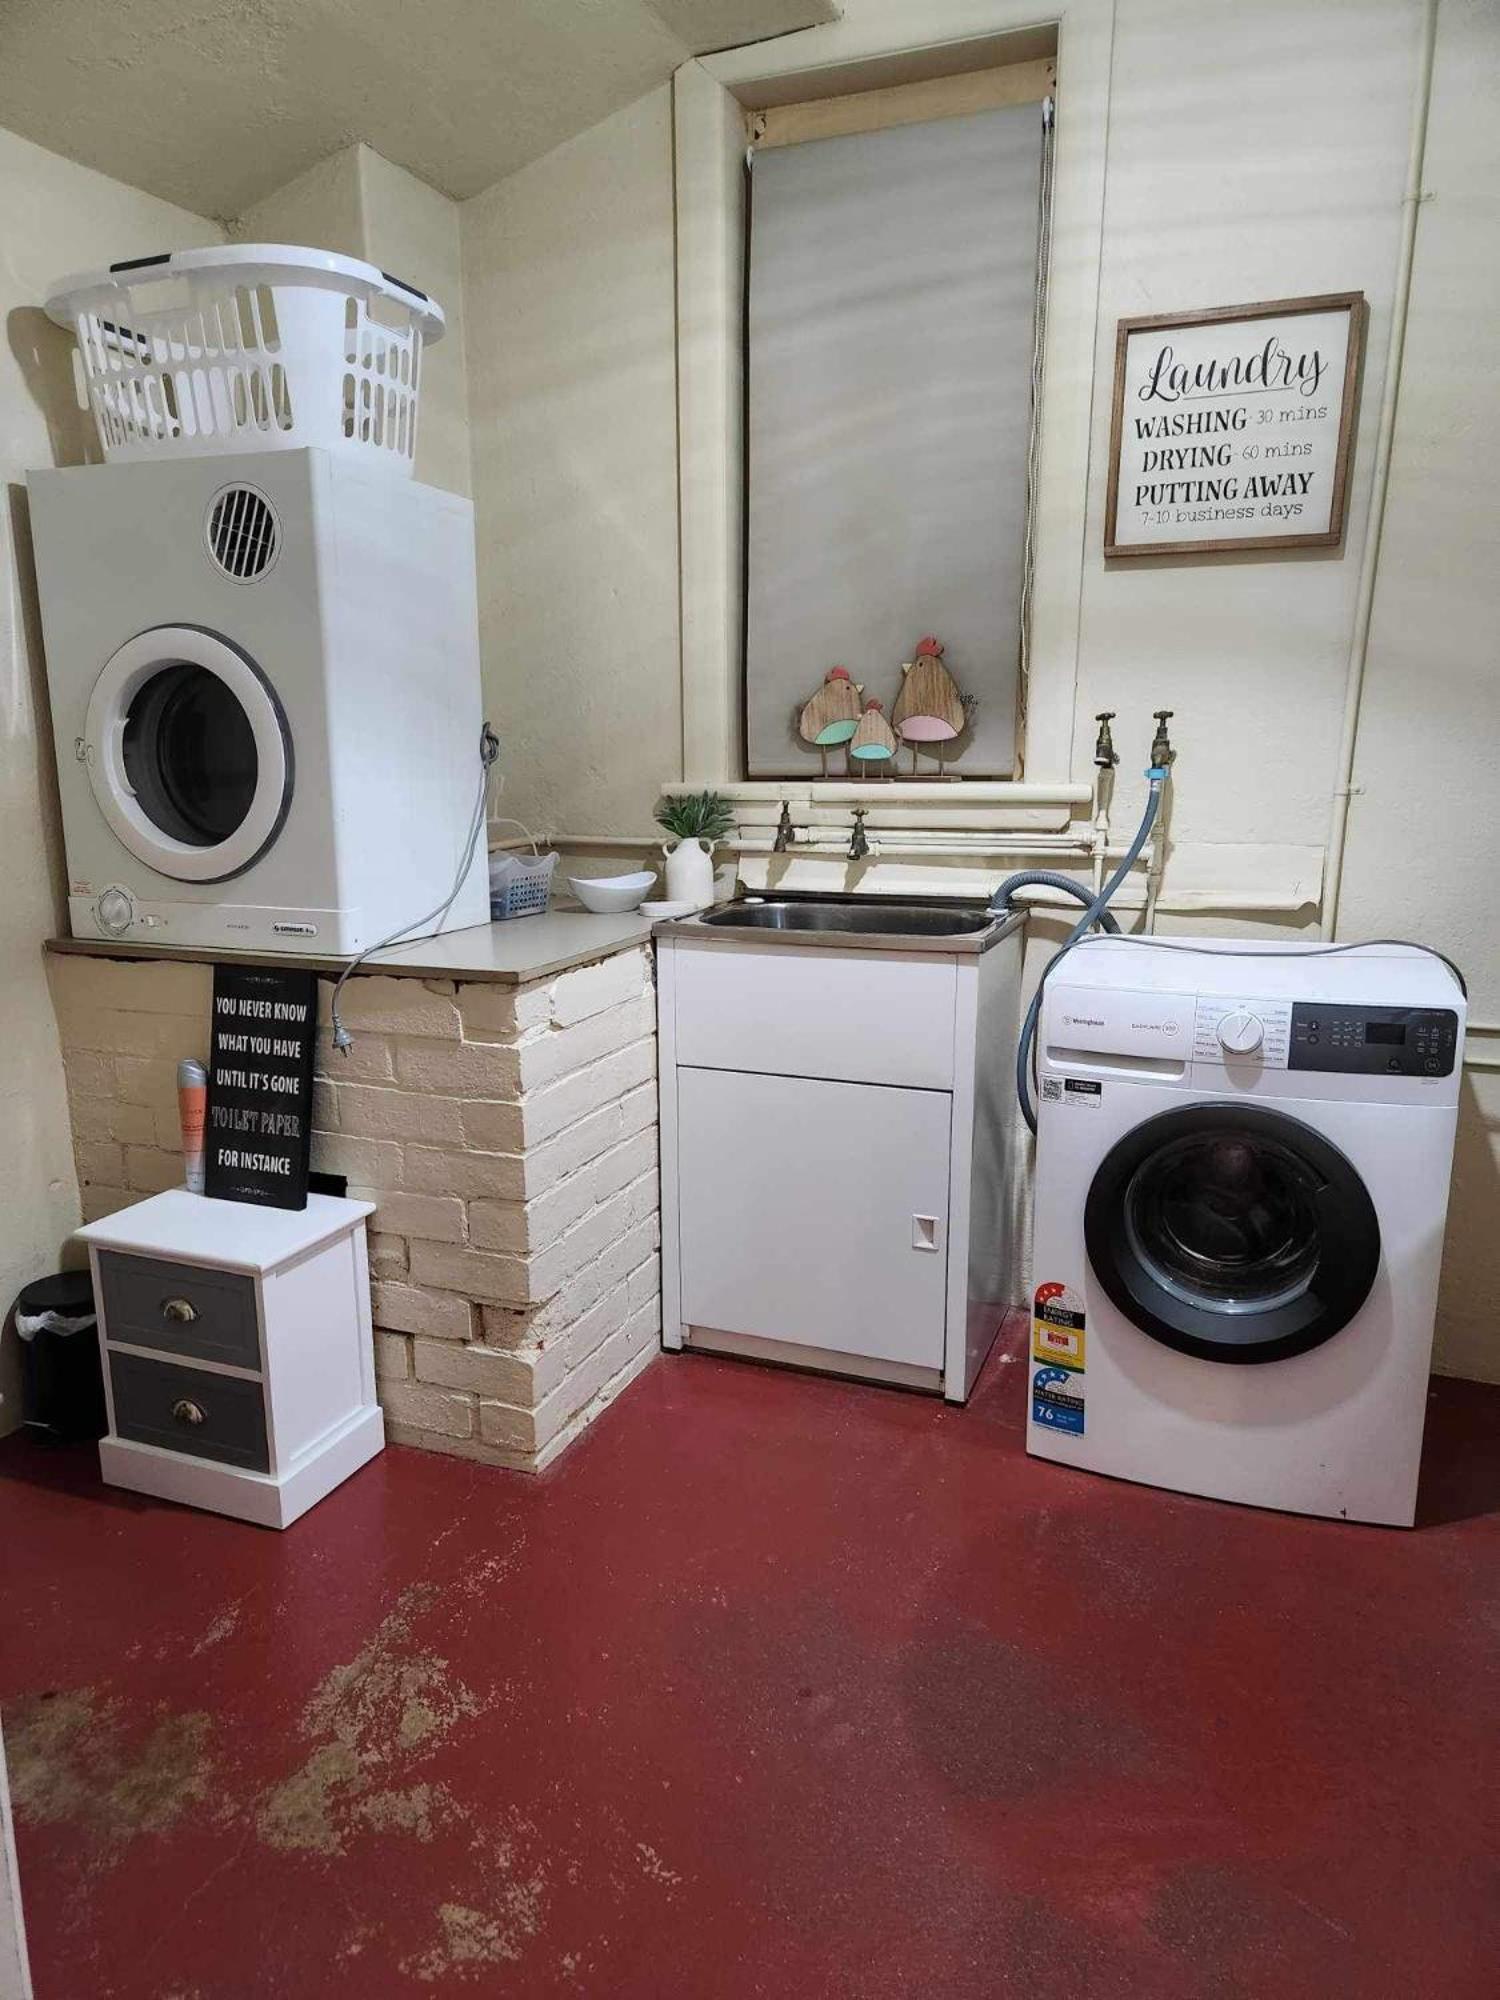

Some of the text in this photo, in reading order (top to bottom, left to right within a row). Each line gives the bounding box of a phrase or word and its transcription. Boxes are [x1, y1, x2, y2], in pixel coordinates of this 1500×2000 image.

[1138, 337, 1328, 401] Laundry
[1135, 405, 1328, 439] WASHING 30 mins
[1142, 443, 1231, 472] DRYING
[1265, 441, 1313, 458] mins
[1135, 471, 1315, 506] PUTTING AWAY
[1142, 502, 1303, 525] 7-10 business days
[216, 996, 307, 1022] YOU NEVER KNOW
[218, 1033, 301, 1058] WHAT YOU HAVE
[216, 1068, 299, 1095] UNTIL IT'S GONE
[211, 1106, 300, 1138] TOILET PAPER
[218, 1148, 291, 1175] FOR INSTANCE
[1037, 1406, 1054, 1420] 76
